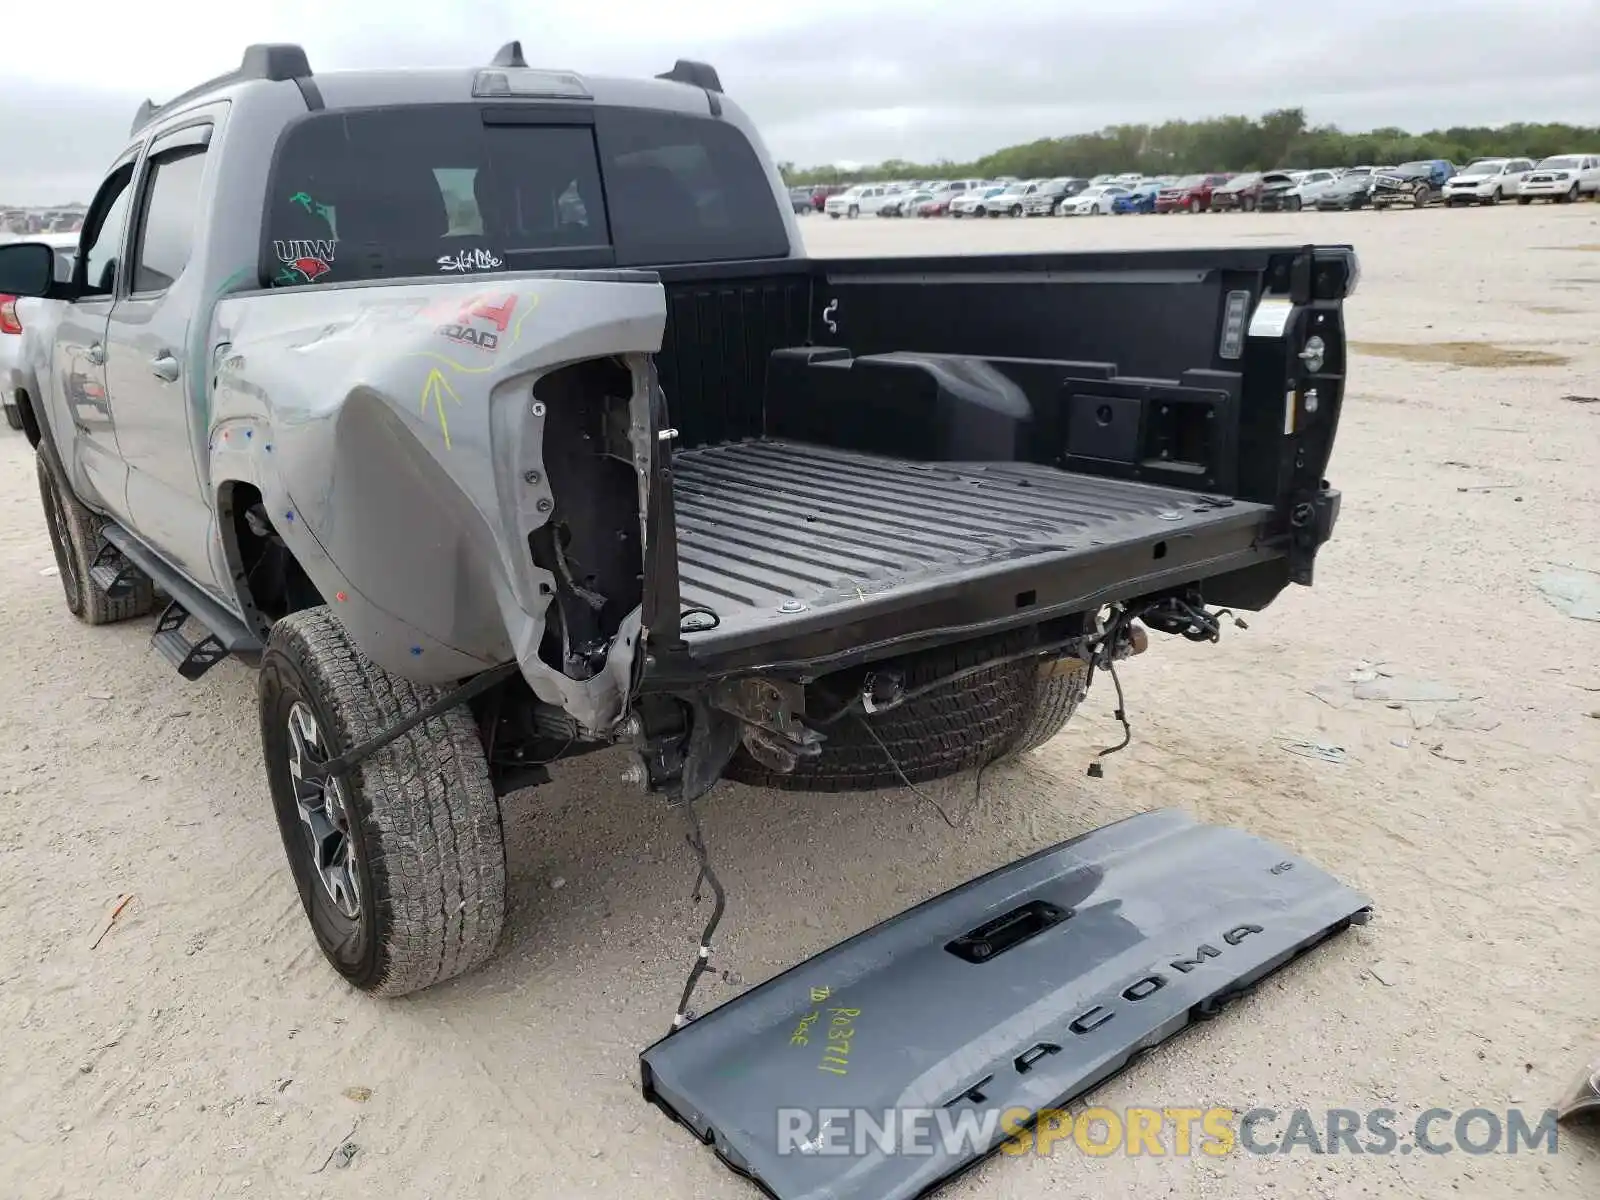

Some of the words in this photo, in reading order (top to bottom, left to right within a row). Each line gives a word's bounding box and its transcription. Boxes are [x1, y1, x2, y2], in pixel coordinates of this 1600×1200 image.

[273, 239, 336, 262] UIW
[438, 324, 498, 349] OAD
[942, 923, 1265, 1107] TACOMA
